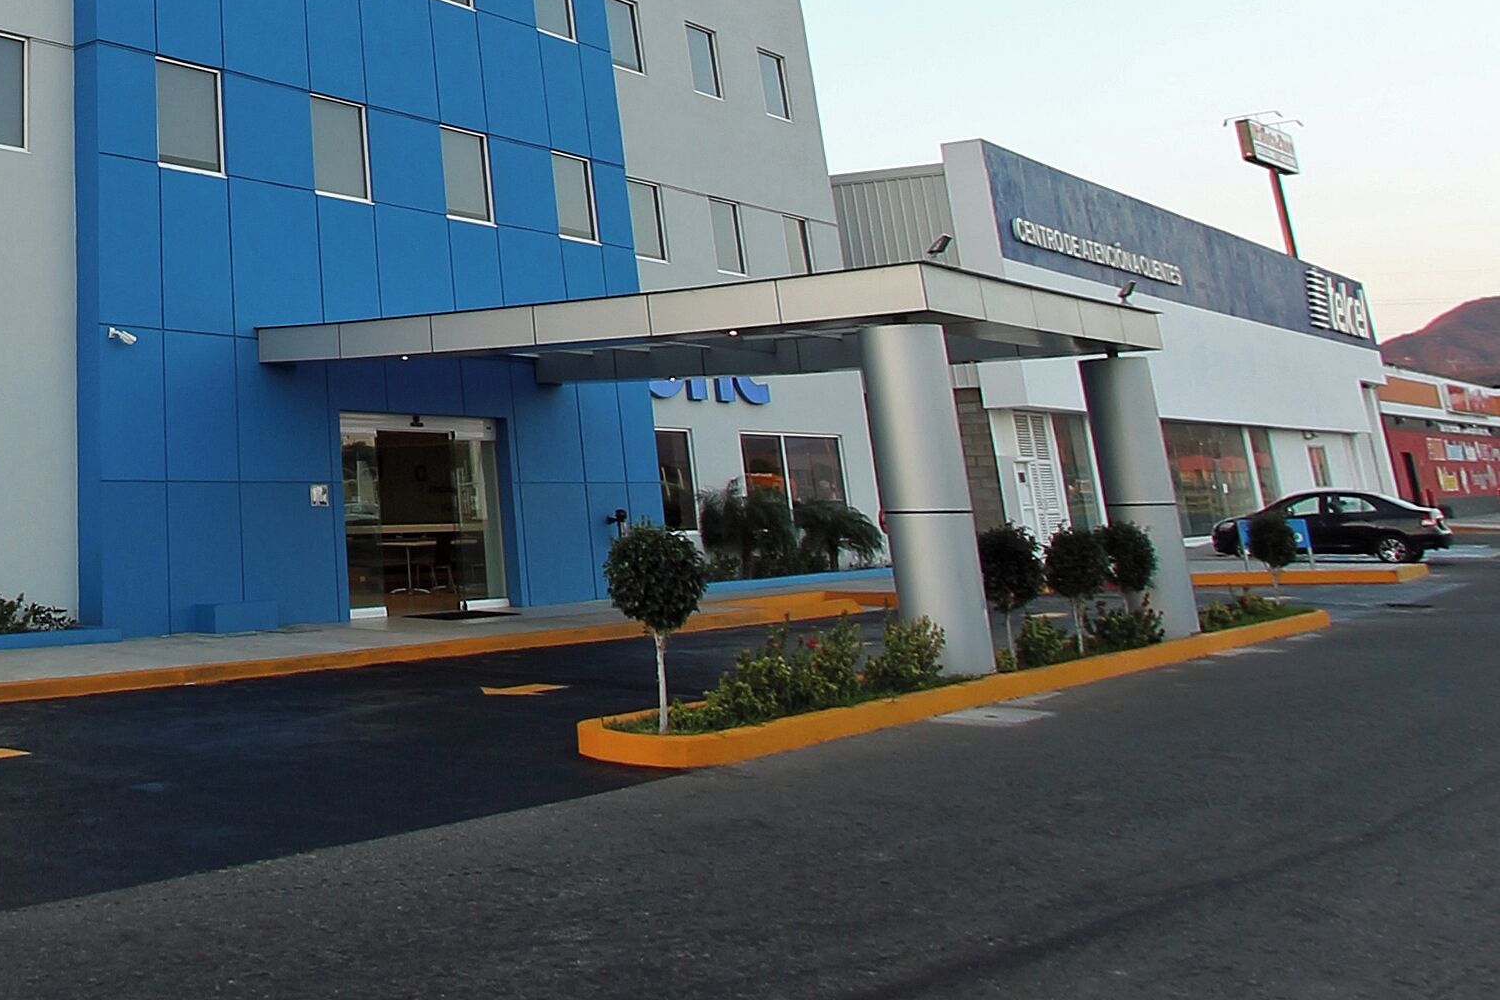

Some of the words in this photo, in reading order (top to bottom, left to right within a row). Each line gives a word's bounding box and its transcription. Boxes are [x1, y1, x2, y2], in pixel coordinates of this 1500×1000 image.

[1014, 217, 1062, 252] CENTRO
[1062, 232, 1081, 258] DE
[1139, 256, 1183, 286] CLIENTES
[1327, 276, 1370, 339] telcel
